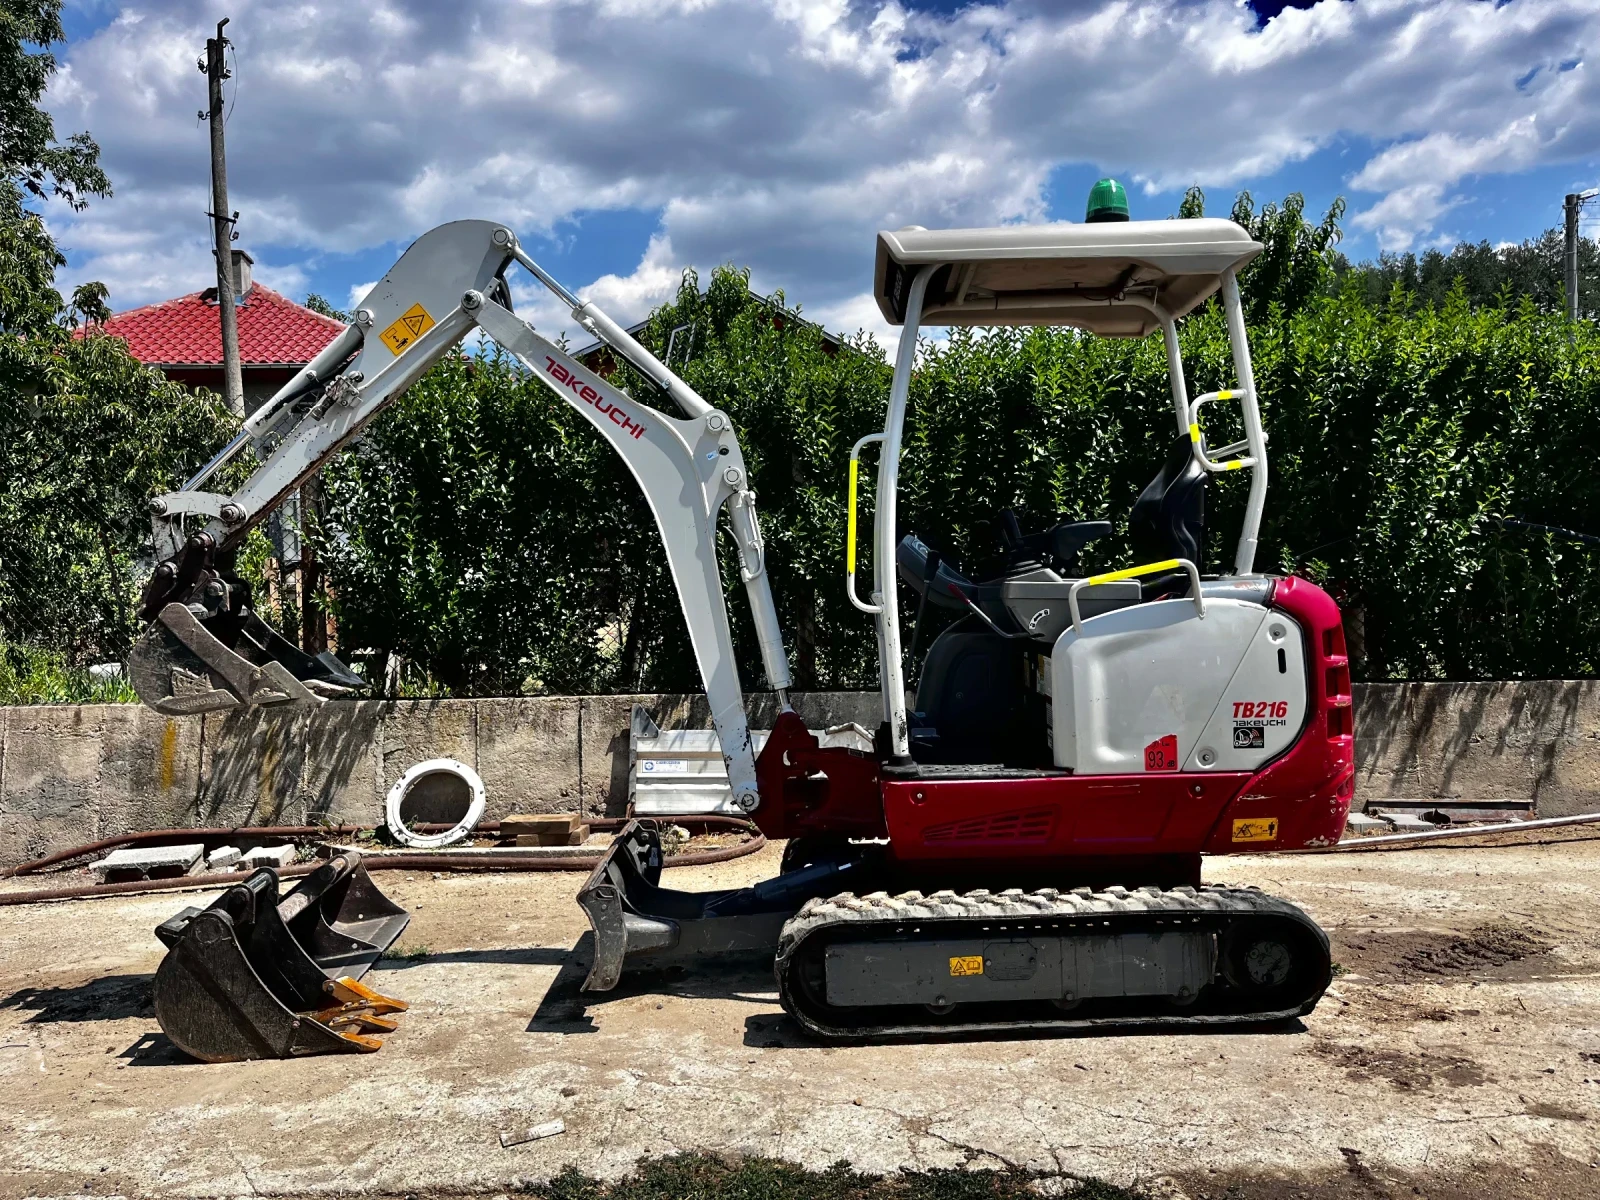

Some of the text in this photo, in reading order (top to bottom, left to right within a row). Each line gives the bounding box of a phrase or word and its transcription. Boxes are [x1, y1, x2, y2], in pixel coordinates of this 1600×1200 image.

[545, 355, 646, 440] TAKEUCHI
[1232, 700, 1288, 719] TB216
[1147, 750, 1176, 769] 93 dB
